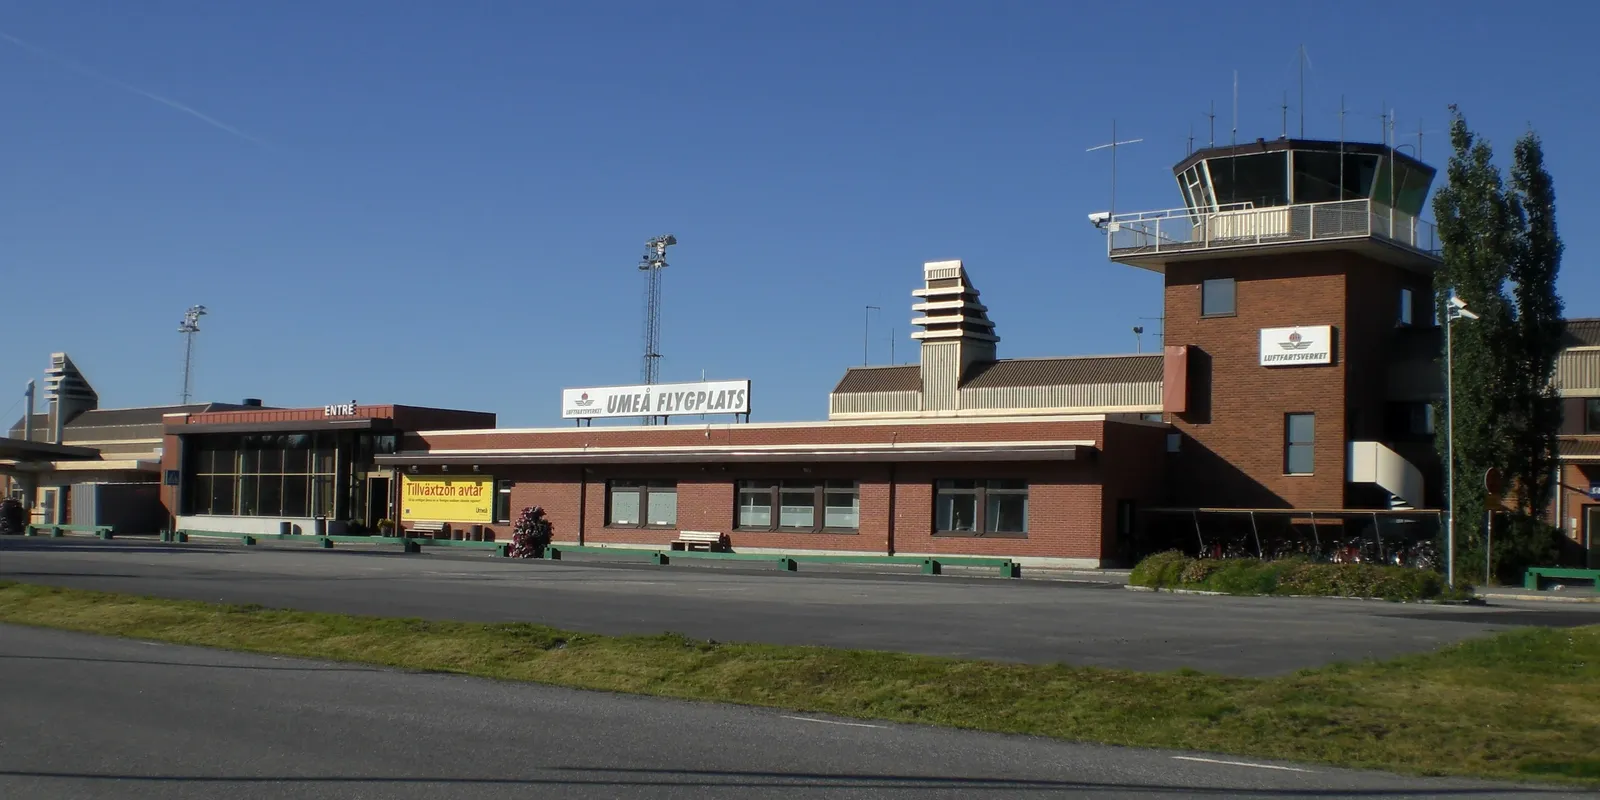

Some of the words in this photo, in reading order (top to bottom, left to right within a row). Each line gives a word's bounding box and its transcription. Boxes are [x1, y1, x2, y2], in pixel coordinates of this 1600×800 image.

[1264, 352, 1328, 362] LUFTFARTSVERKET
[324, 400, 354, 416] ENTRÉ
[607, 387, 651, 414] UMEÅ
[657, 388, 745, 412] FLYGPLATS
[406, 482, 456, 497] Tillväxtzon
[459, 485, 484, 497] avtar
